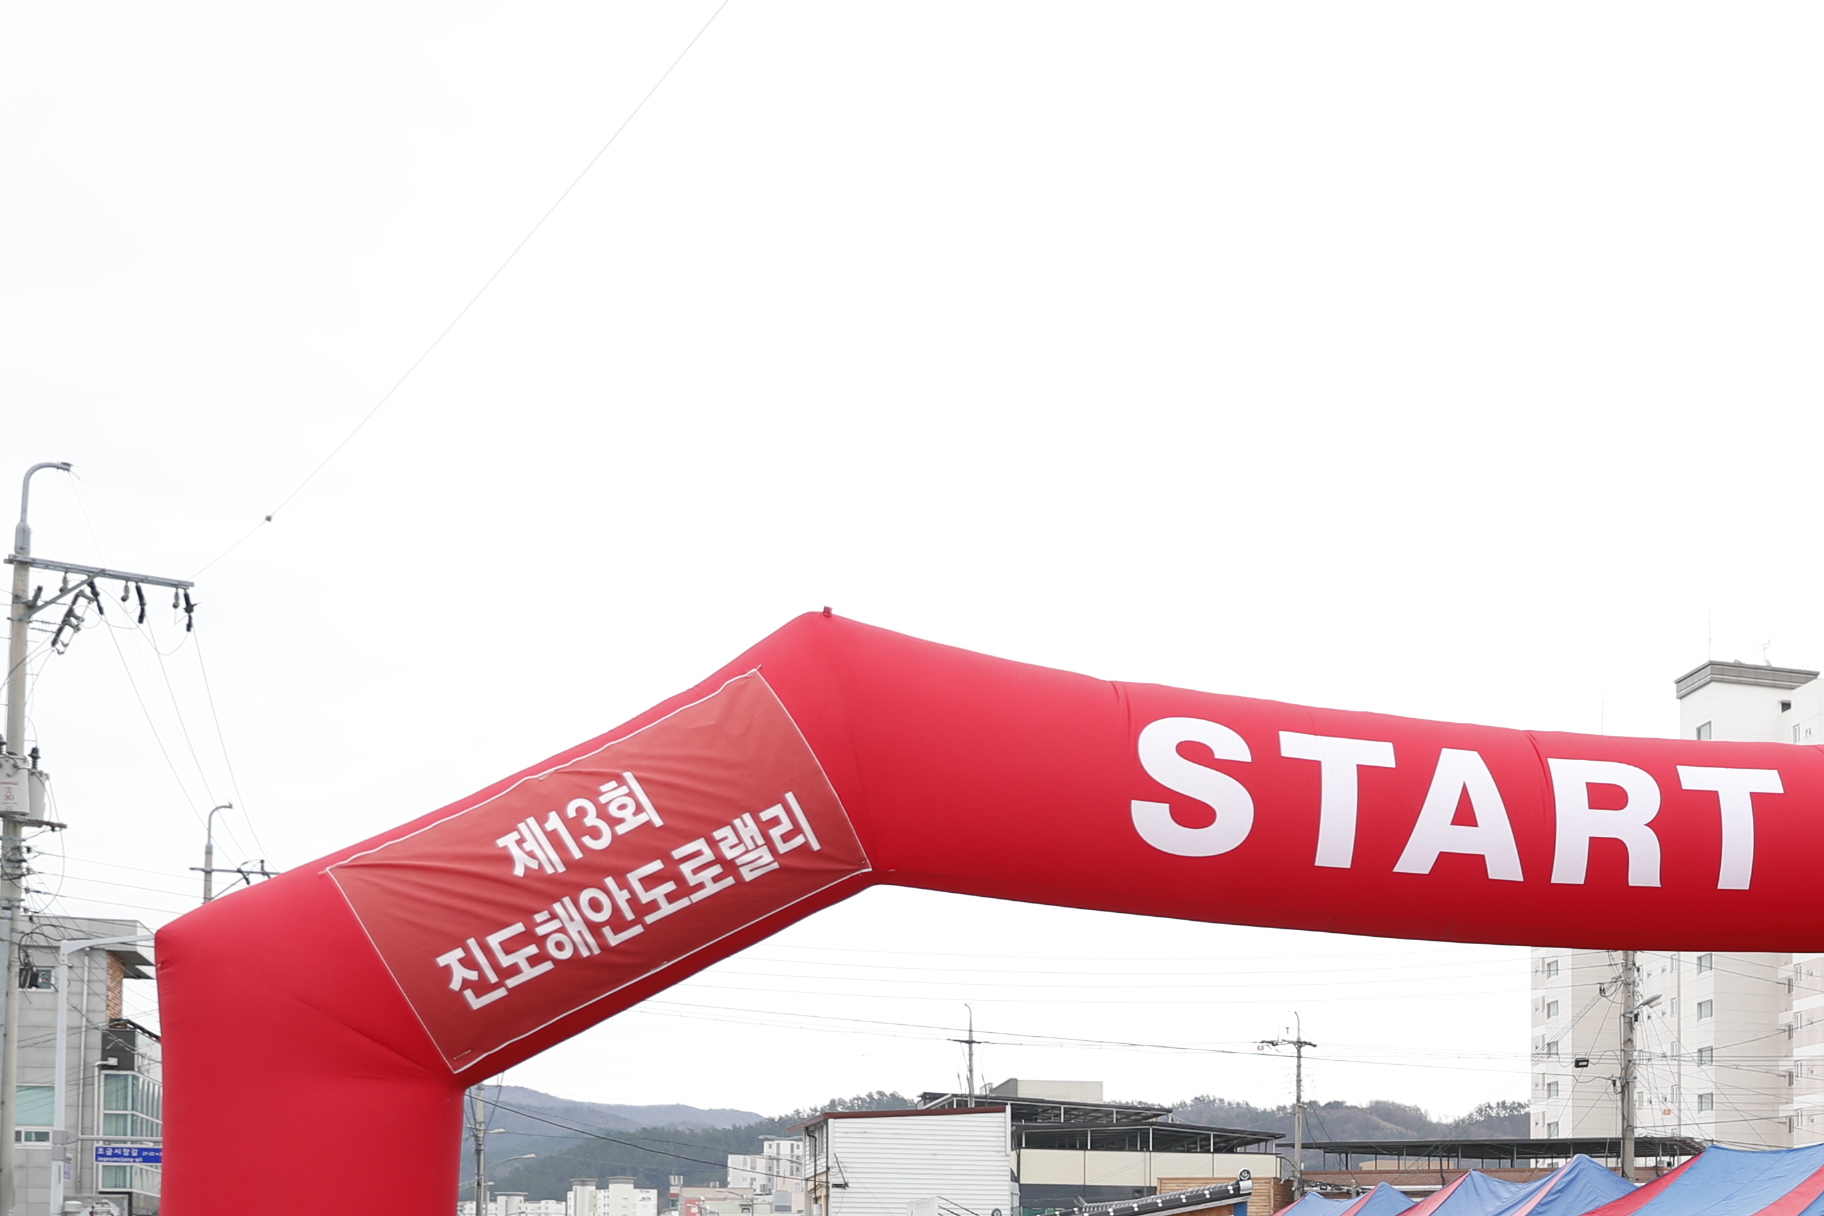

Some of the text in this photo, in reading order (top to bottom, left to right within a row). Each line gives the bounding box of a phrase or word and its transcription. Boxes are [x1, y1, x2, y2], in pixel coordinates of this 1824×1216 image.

[495, 771, 664, 878] 제13회
[1131, 716, 1785, 891] START
[435, 792, 822, 1011] 진도해안도로랠리
